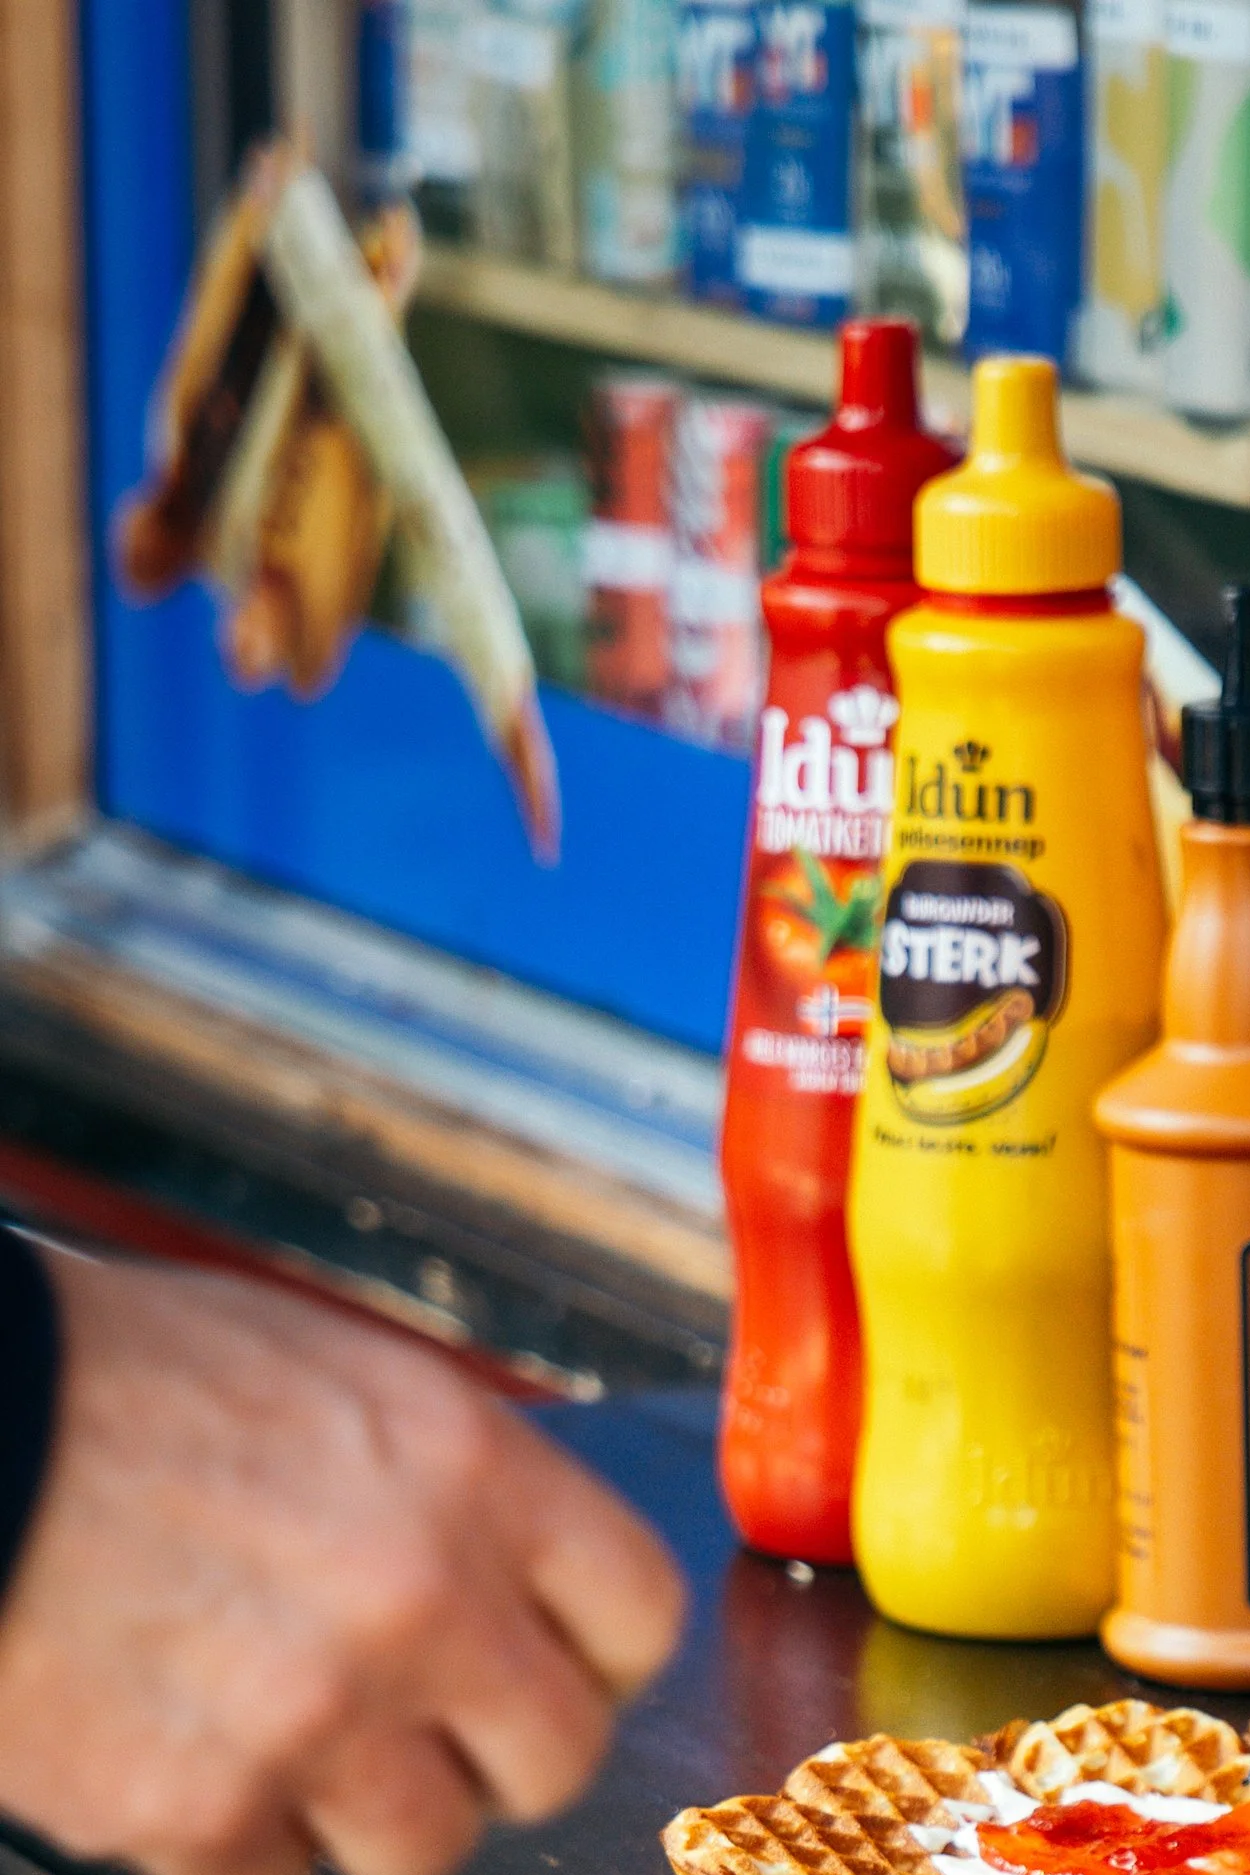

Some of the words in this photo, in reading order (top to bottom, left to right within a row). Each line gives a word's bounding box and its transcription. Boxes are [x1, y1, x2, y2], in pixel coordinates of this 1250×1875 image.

[757, 706, 896, 813] Idu
[906, 755, 1036, 825] Idun
[881, 918, 1042, 989] STERK
